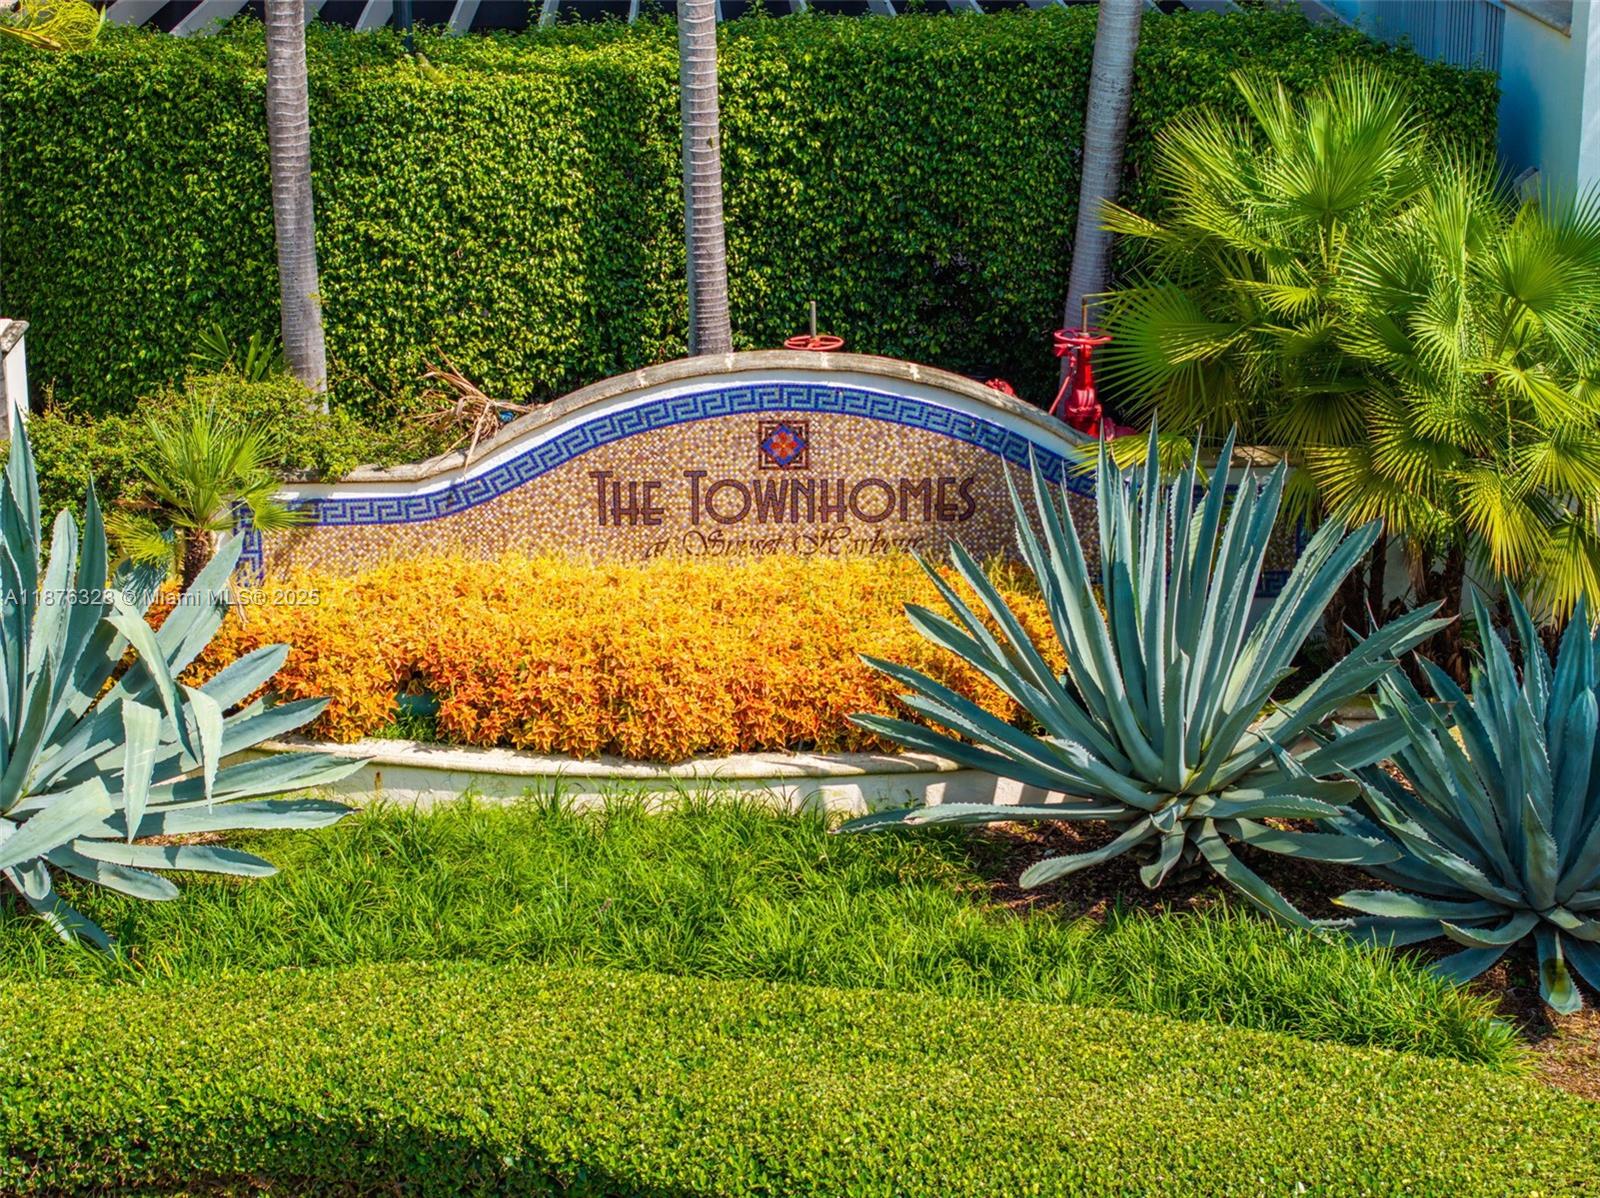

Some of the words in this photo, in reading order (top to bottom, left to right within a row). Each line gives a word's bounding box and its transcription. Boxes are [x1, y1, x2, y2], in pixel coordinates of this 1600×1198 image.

[589, 470, 664, 526] THE
[683, 470, 976, 525] TOWNHOMES
[645, 537, 670, 558] at
[682, 529, 785, 557] Sunset
